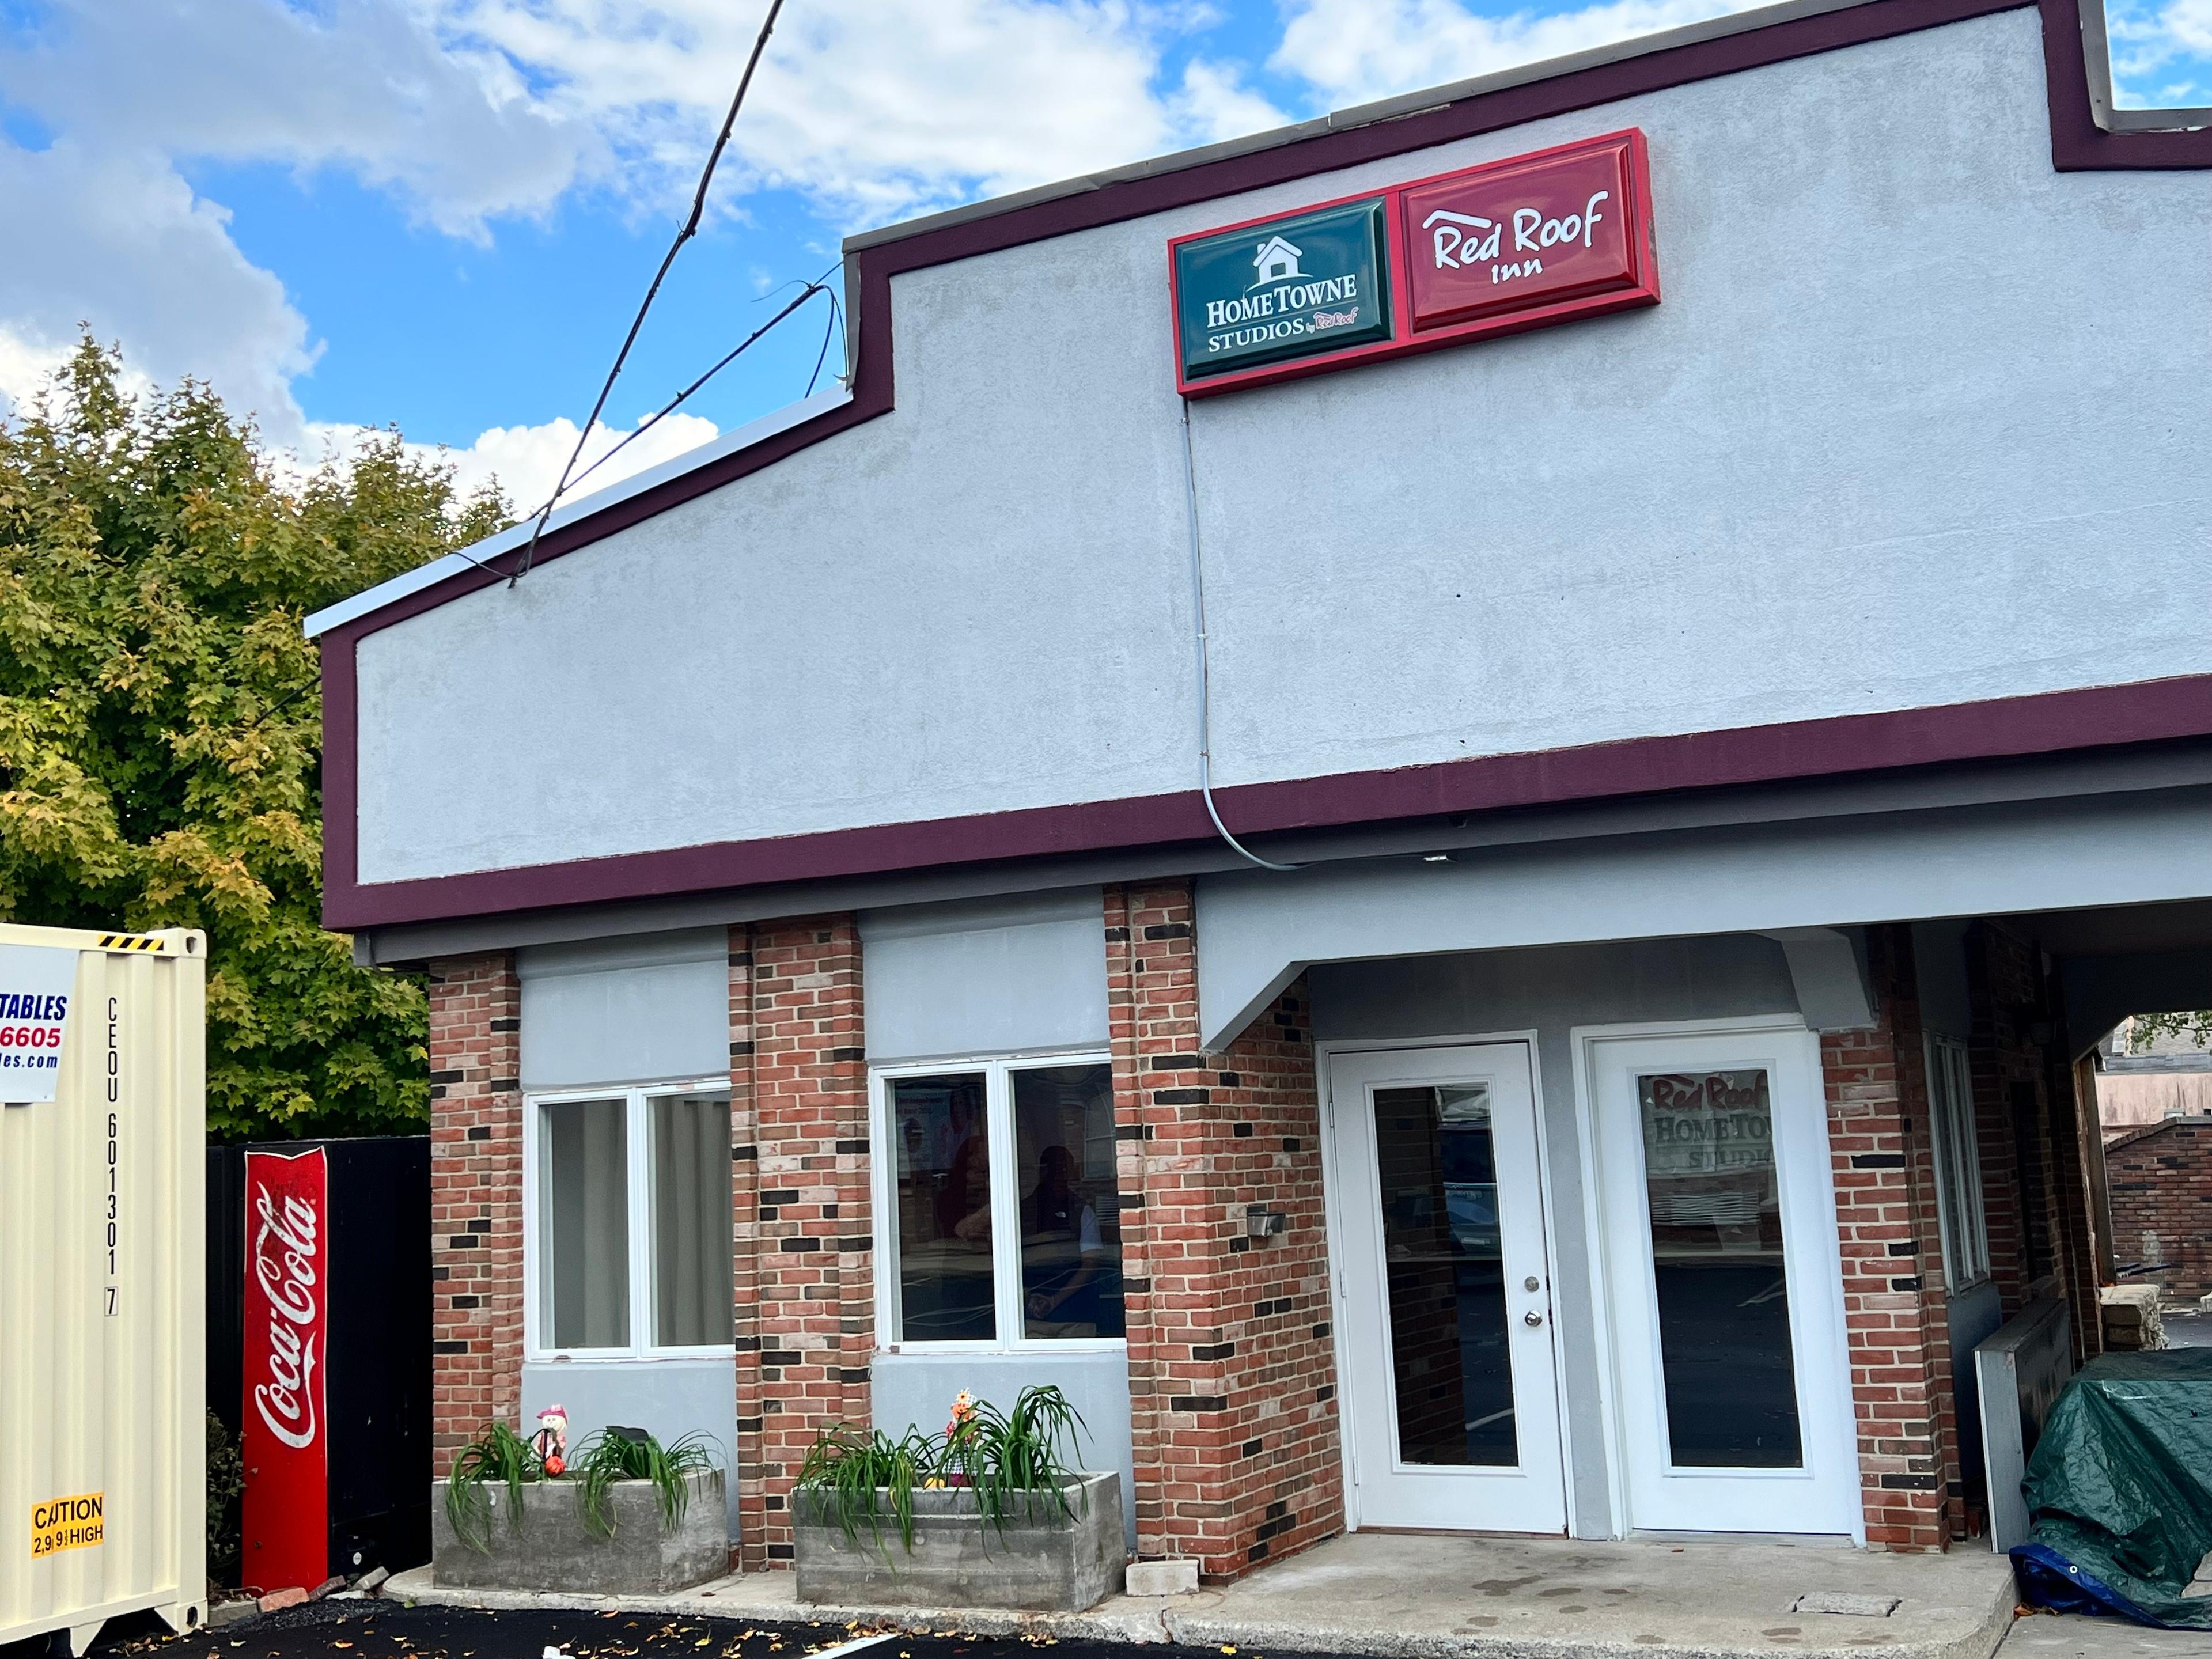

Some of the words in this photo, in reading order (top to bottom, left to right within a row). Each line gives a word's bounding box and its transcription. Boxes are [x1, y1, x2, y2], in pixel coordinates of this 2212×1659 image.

[1433, 222, 1502, 269] Red
[1513, 190, 1609, 252] Roof
[1208, 317, 1305, 353] STUDIOS
[1306, 322, 1316, 334] by
[1314, 313, 1335, 329] Red
[1333, 306, 1359, 327] Roof
[0, 993, 67, 1021] TABLES
[0, 1026, 61, 1048] 6605
[1653, 1079, 1703, 1111] Red
[1706, 1070, 1768, 1111] Roof
[1654, 1115, 1771, 1142] HOMETO
[107, 1113, 117, 1275] 601301
[107, 1288, 116, 1315] 7
[255, 1180, 317, 1449] Coca-Cola
[70, 1524, 103, 1544] HIGH
